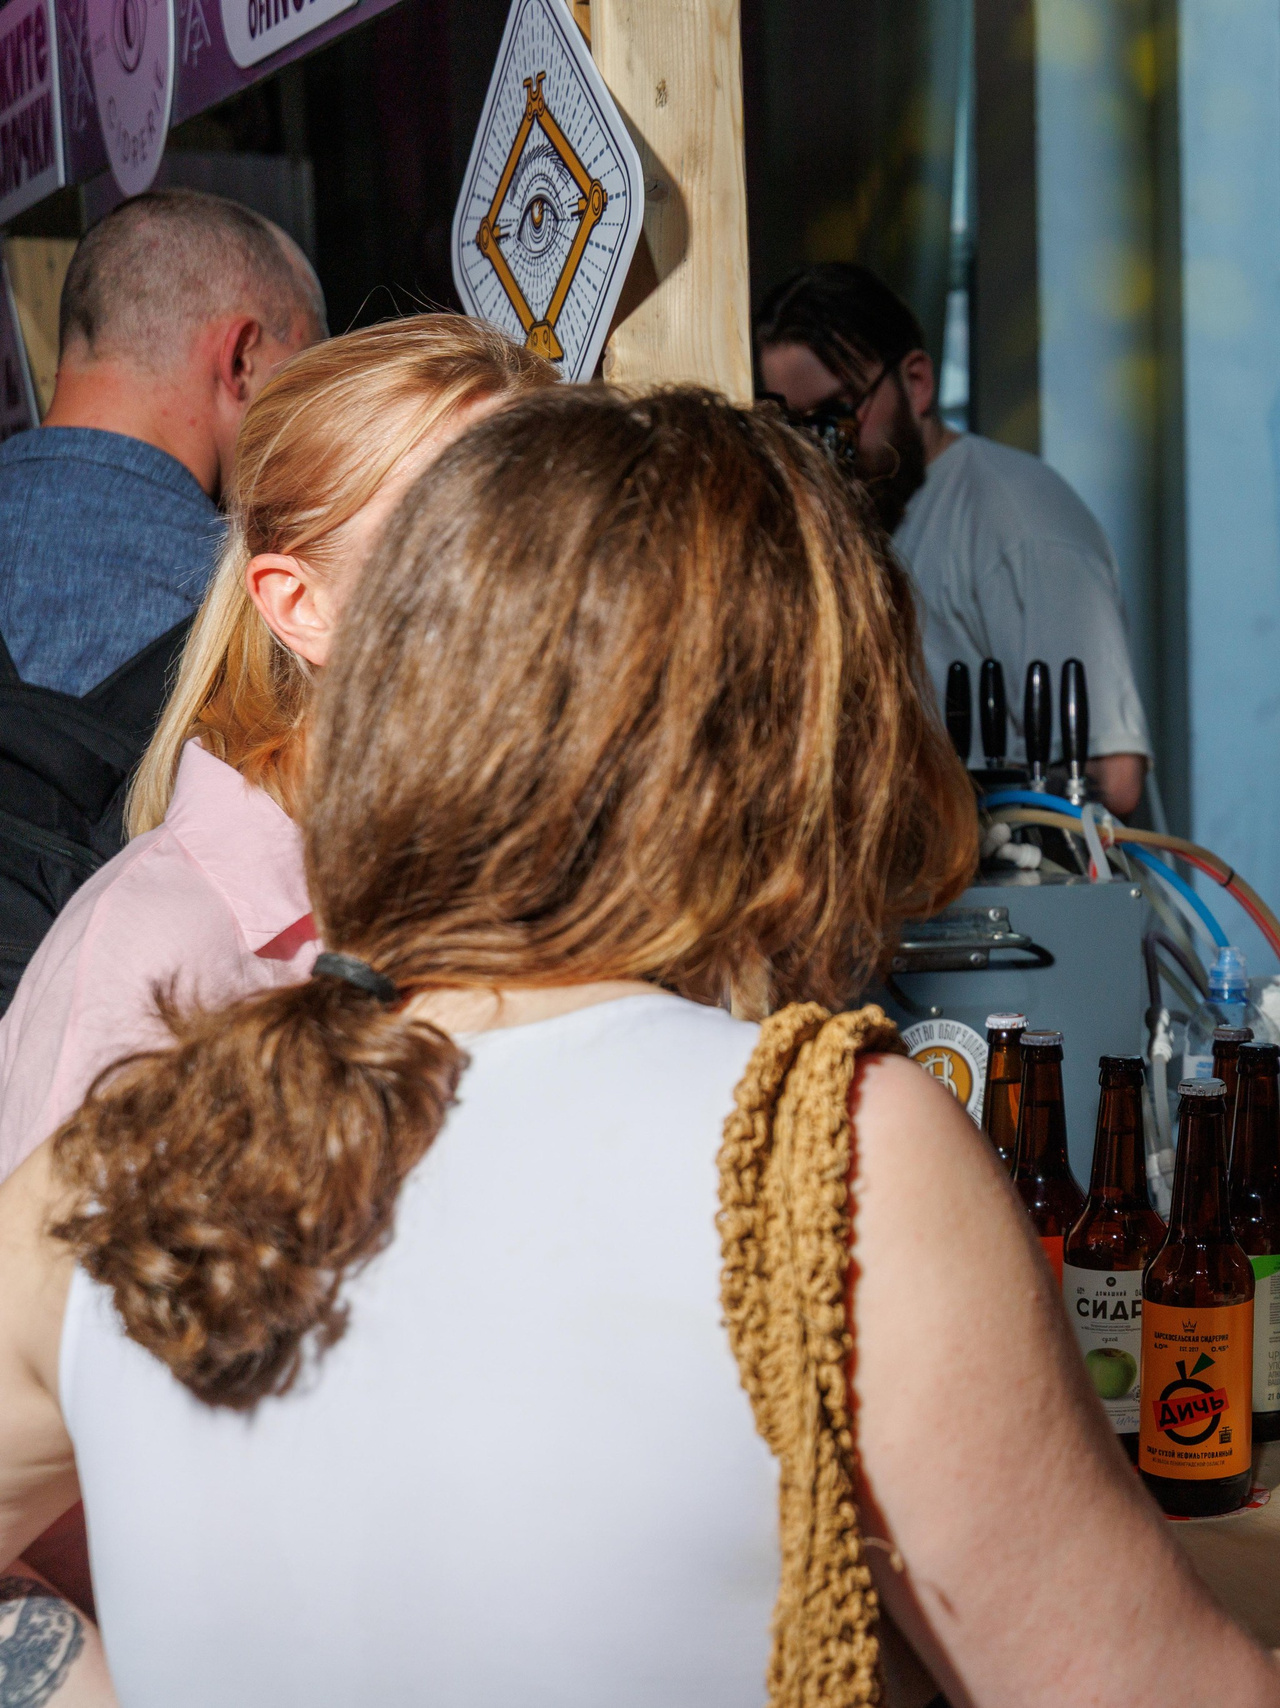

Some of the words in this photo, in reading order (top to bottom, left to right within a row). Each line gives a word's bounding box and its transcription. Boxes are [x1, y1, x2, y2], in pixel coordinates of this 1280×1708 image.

[1076, 1298, 1142, 1321] СИДР
[1154, 1331, 1200, 1343] ЦАРСКОСЕЛЬСКАЯ
[1200, 1334, 1229, 1343] СИДРЕРИЯ
[1159, 1396, 1225, 1428] Дичь
[1158, 1448, 1176, 1459] СУХОЙ
[1177, 1447, 1233, 1459] НЕФИЛЬТРОВАННЫЙ
